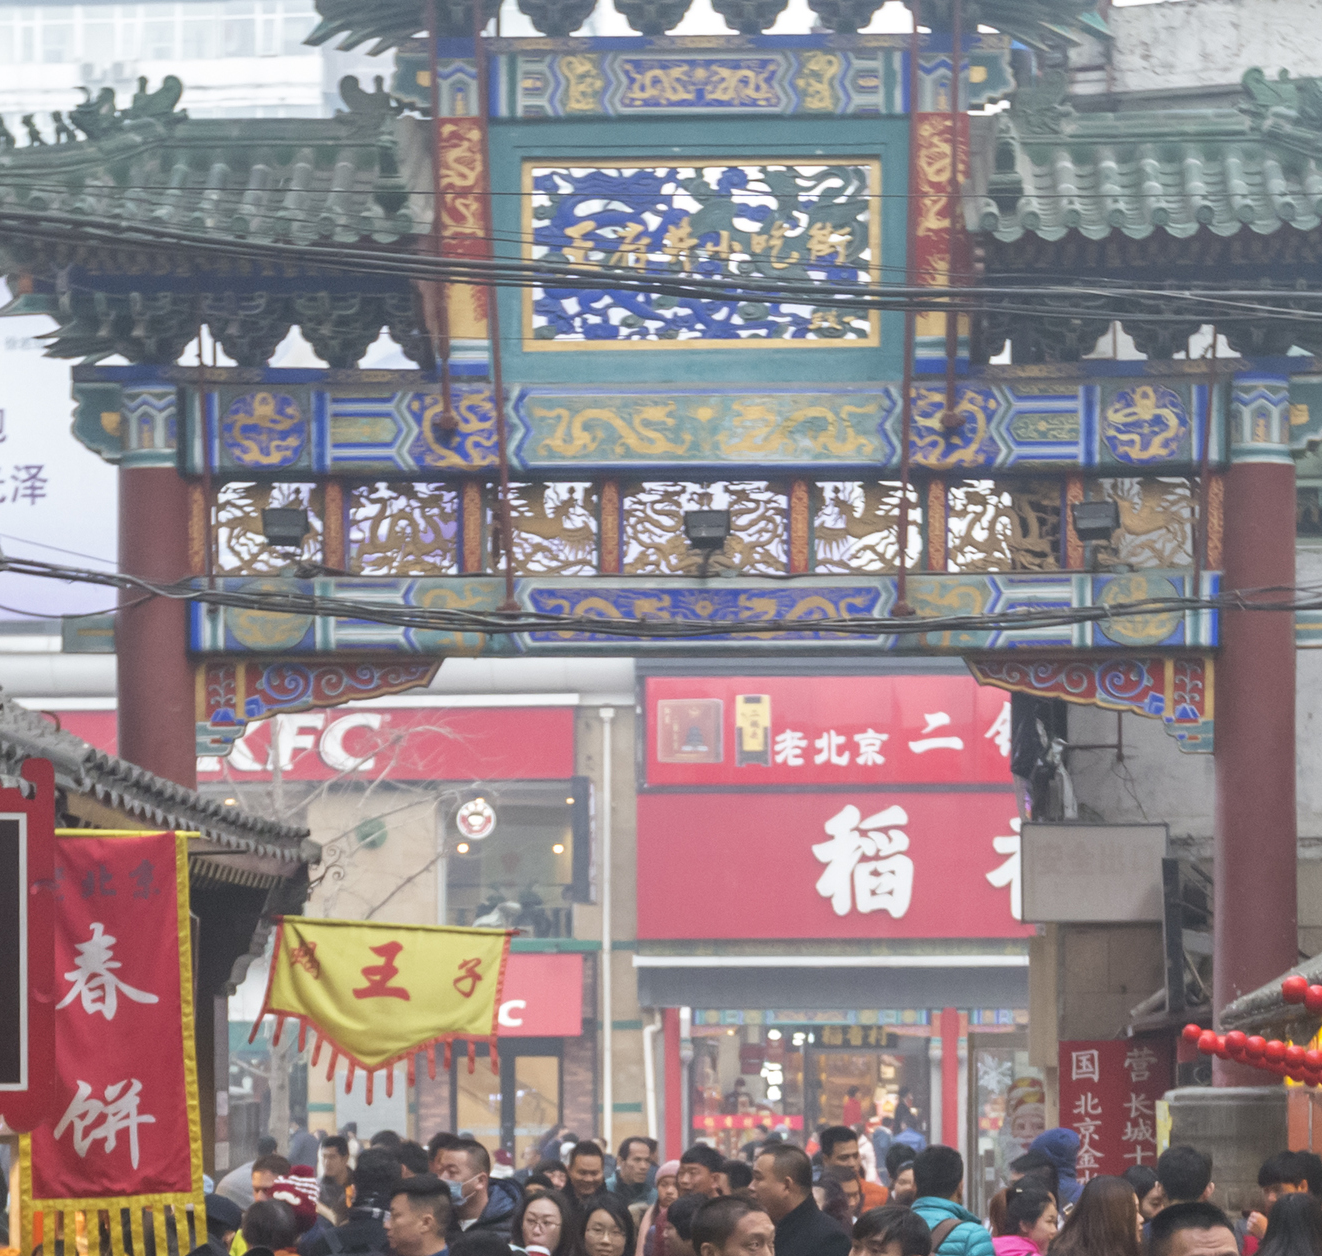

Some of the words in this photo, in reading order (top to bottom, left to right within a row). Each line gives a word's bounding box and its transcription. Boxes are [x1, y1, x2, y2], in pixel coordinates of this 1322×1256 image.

[563, 216, 853, 272] 王府井小吃街
[197, 712, 383, 773] KFC
[774, 728, 889, 766] 老北京
[55, 859, 161, 901] 北京
[54, 922, 160, 1171] 春饼
